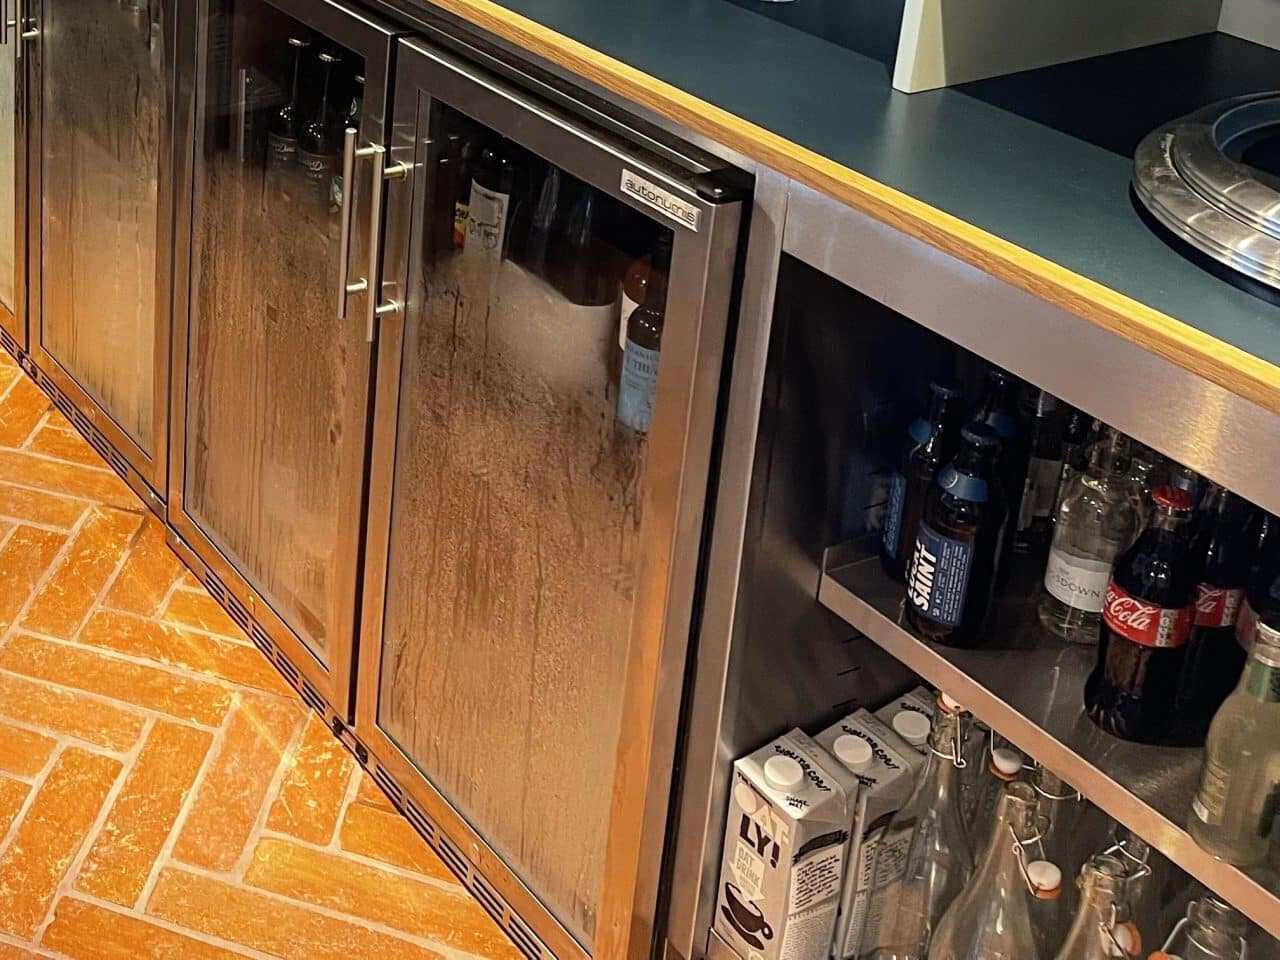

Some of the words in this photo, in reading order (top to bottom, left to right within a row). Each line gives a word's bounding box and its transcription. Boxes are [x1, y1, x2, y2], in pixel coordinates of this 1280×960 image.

[624, 178, 696, 223] autonumis
[913, 543, 937, 612] SAINT
[739, 813, 781, 869] LY!
